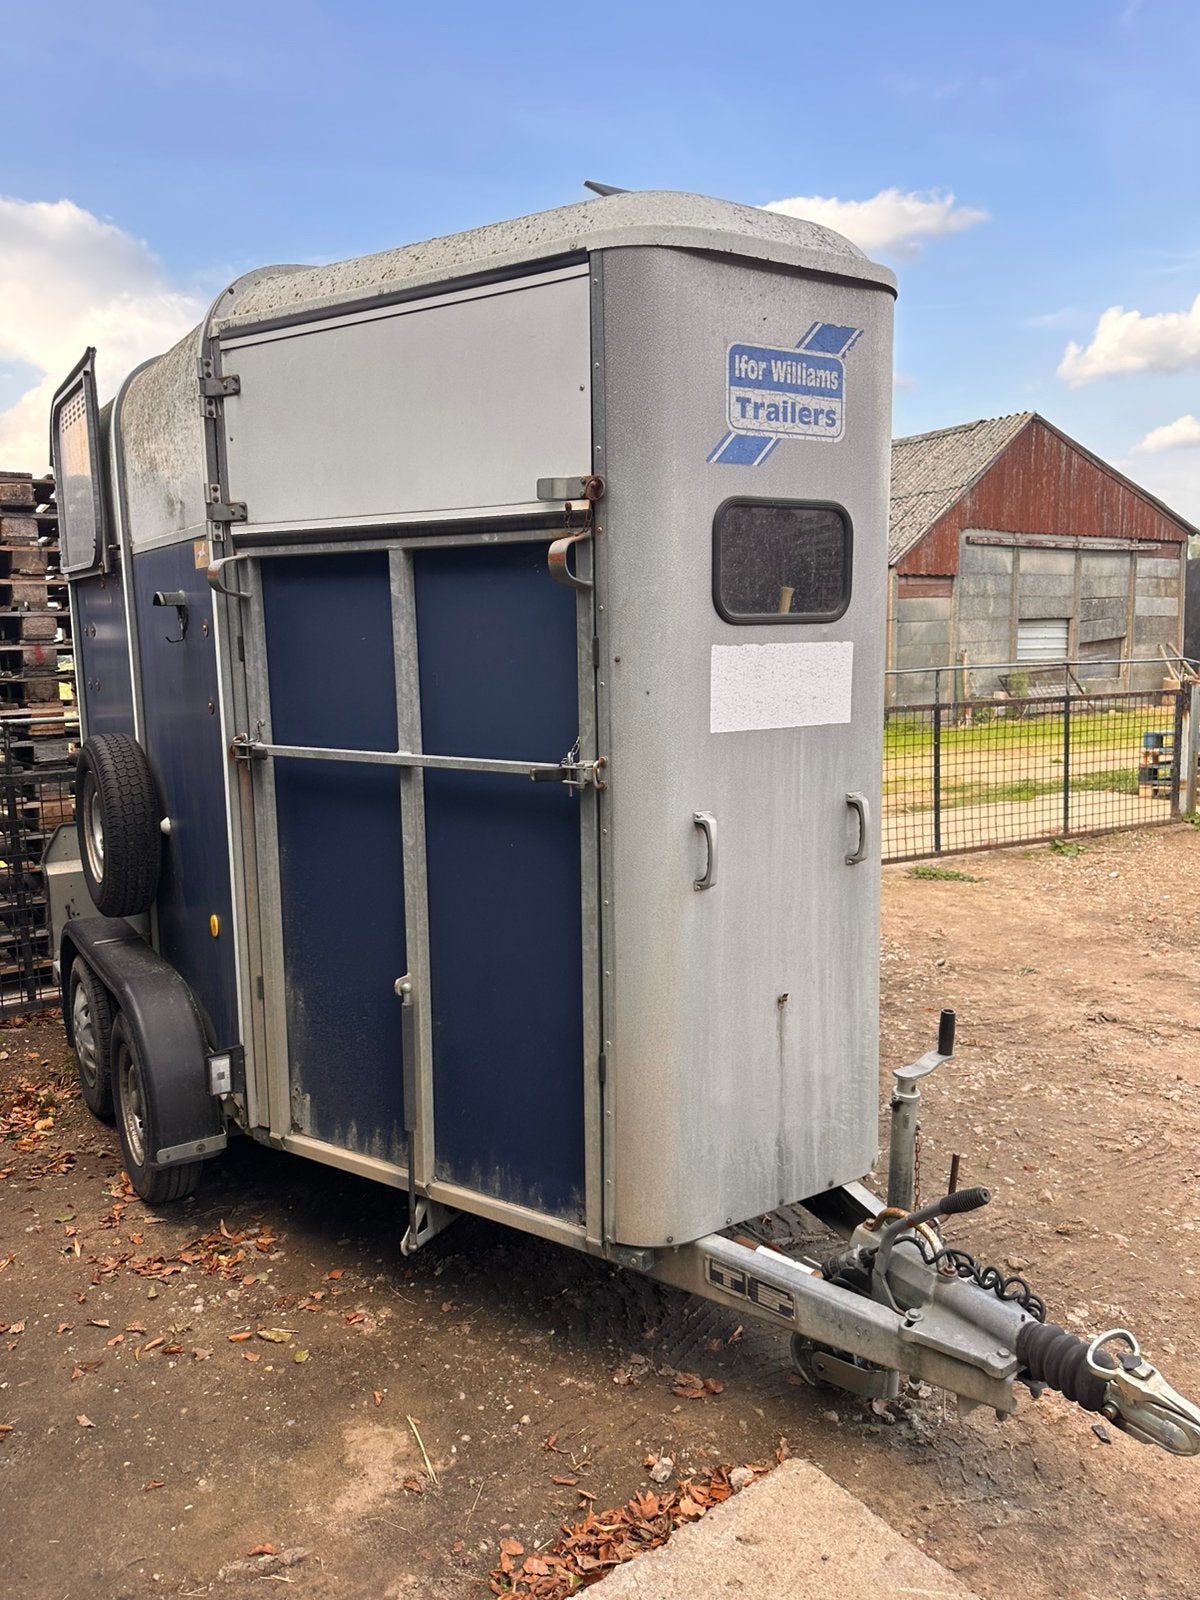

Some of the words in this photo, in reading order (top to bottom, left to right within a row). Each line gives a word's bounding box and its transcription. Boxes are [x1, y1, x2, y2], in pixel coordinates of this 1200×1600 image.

[735, 354, 767, 380] Ifor
[771, 359, 839, 390] Williams
[735, 396, 837, 428] Trailers
